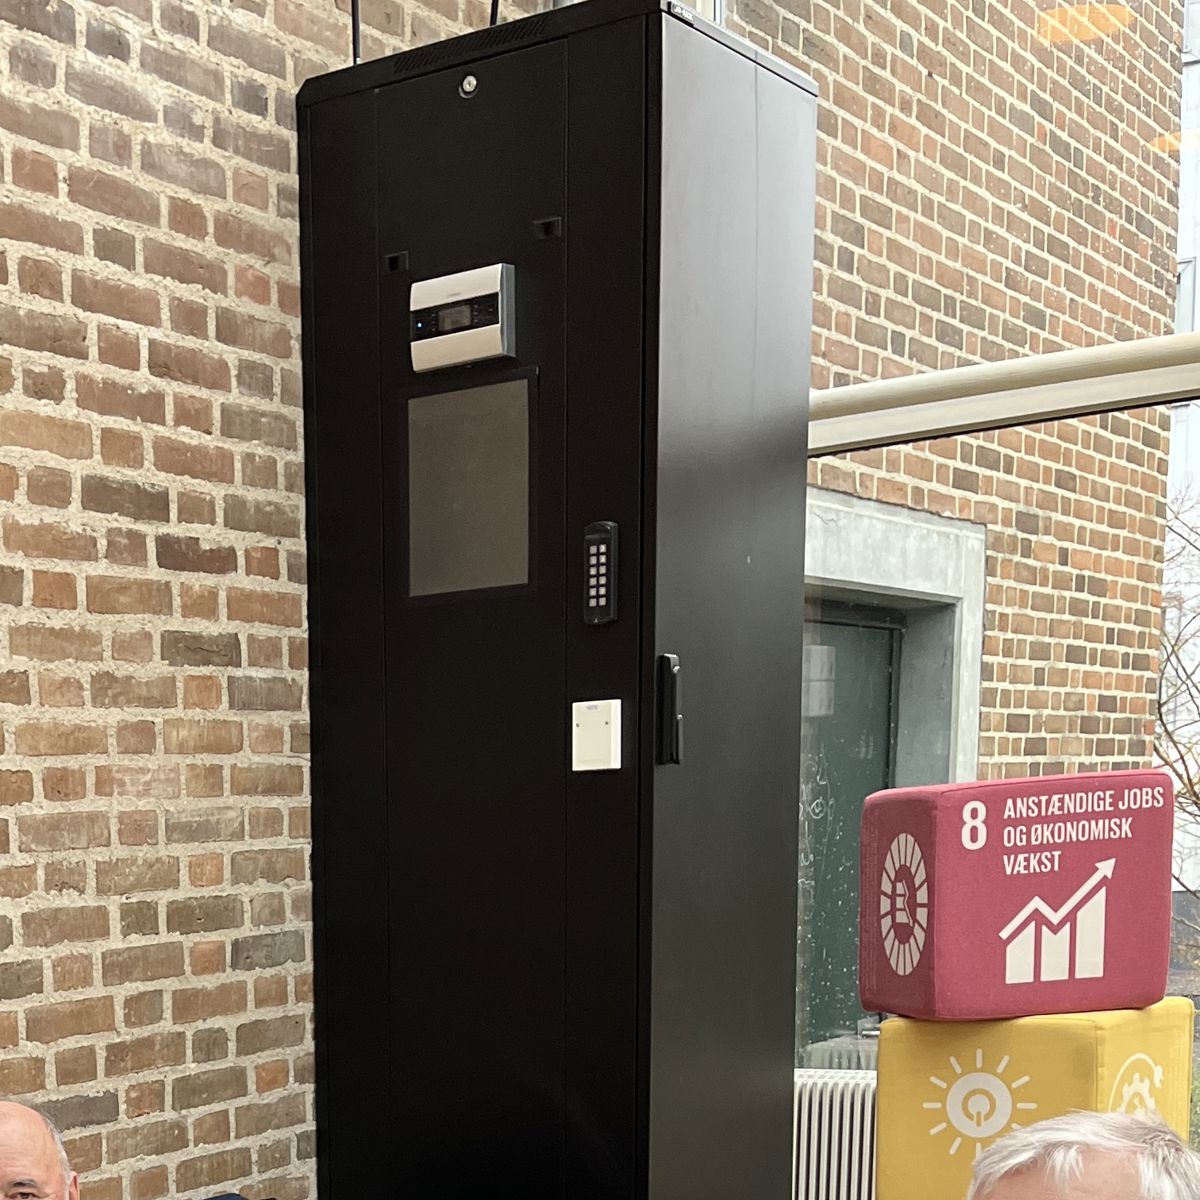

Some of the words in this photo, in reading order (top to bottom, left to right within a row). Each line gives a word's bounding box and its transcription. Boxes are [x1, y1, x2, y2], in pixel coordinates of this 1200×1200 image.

[961, 800, 987, 850] 8
[1003, 790, 1115, 820] ANSTÆNDIGE
[1118, 786, 1164, 810] JOBS
[1003, 825, 1028, 848] OG
[1030, 816, 1133, 847] ØKONOMISK
[1003, 850, 1063, 876] VÆKST
